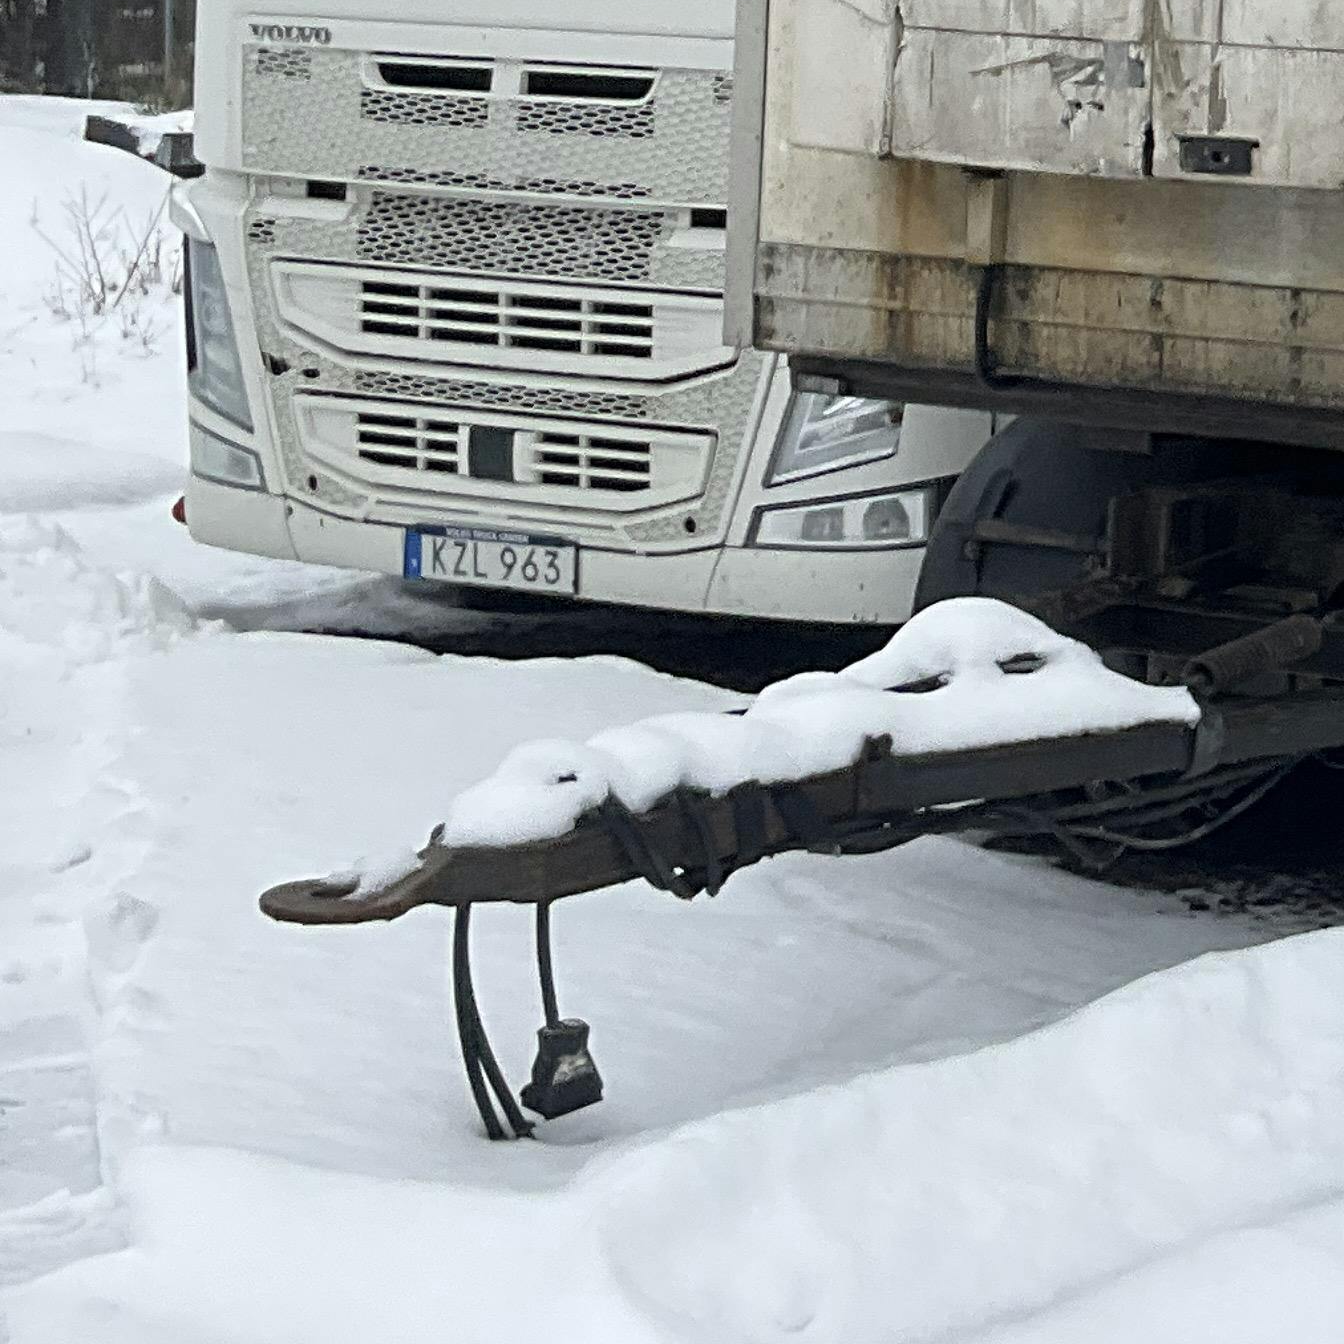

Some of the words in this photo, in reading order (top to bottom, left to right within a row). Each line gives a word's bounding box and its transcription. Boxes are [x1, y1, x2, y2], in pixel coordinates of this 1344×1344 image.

[248, 23, 333, 45] VOLVO
[432, 537, 488, 579] KZL
[500, 545, 560, 586] 963
